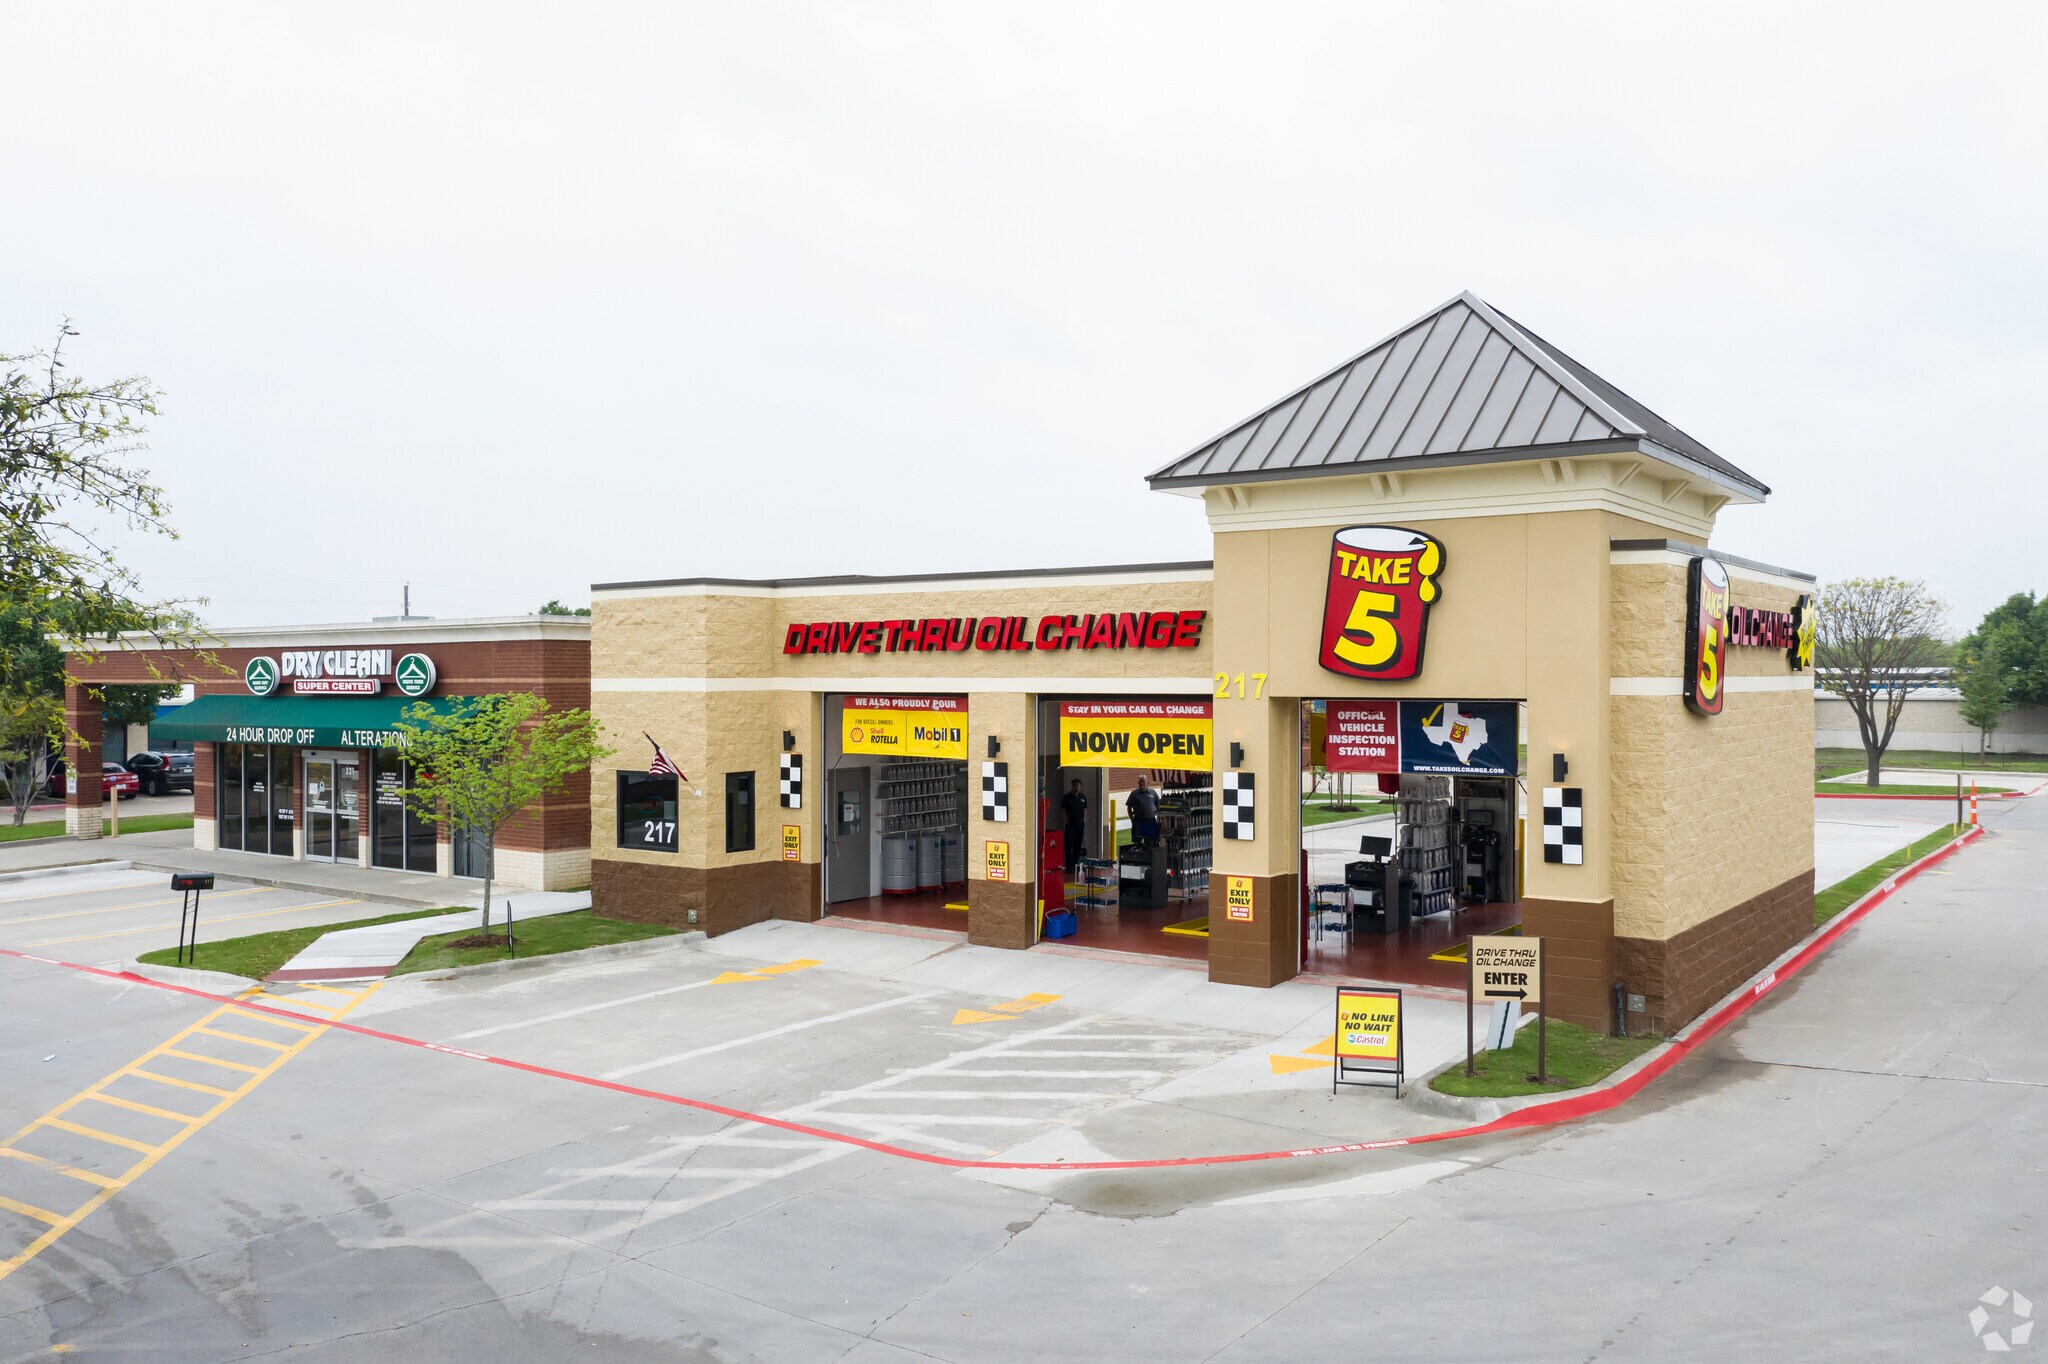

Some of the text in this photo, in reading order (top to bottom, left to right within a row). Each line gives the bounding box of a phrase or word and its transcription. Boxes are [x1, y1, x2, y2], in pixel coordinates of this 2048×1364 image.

[1337, 550, 1412, 584] TAKE
[1702, 582, 1722, 619] TAKE
[783, 610, 1205, 654] DRIVE THRU OIL CHANGE
[1333, 590, 1400, 668] 5
[1731, 605, 1750, 646] OIL
[1751, 608, 1794, 649] CHANGE
[282, 650, 388, 678] DRY CLEAN
[1700, 624, 1718, 700] 5
[298, 682, 371, 690] SUPER CENTER
[1215, 672, 1267, 699] 217
[855, 698, 956, 709] WE ALSO PROUDLY POUR
[1166, 706, 1204, 714] CHANGE
[1338, 711, 1386, 720] OFFICIAL
[1339, 723, 1384, 732] VEHICLE
[227, 727, 314, 743] 24 HOUR DROP OFF
[914, 727, 947, 741] Mobil
[1453, 730, 1461, 738] 5
[870, 735, 898, 744] ROTELLA
[1069, 732, 1204, 755] NOW OPEN
[1329, 735, 1395, 744] INSPECTION
[1339, 747, 1385, 756] STATION
[345, 767, 354, 775] 221
[644, 821, 675, 843] 217
[1229, 897, 1250, 905] ONLY
[1509, 949, 1536, 957] THRU
[1493, 958, 1536, 967] CHANGE
[1484, 972, 1528, 985] ENTER
[1371, 1014, 1395, 1022] LINE
[1345, 1022, 1392, 1032] NO WAIT
[1356, 1035, 1385, 1044] Castrol
